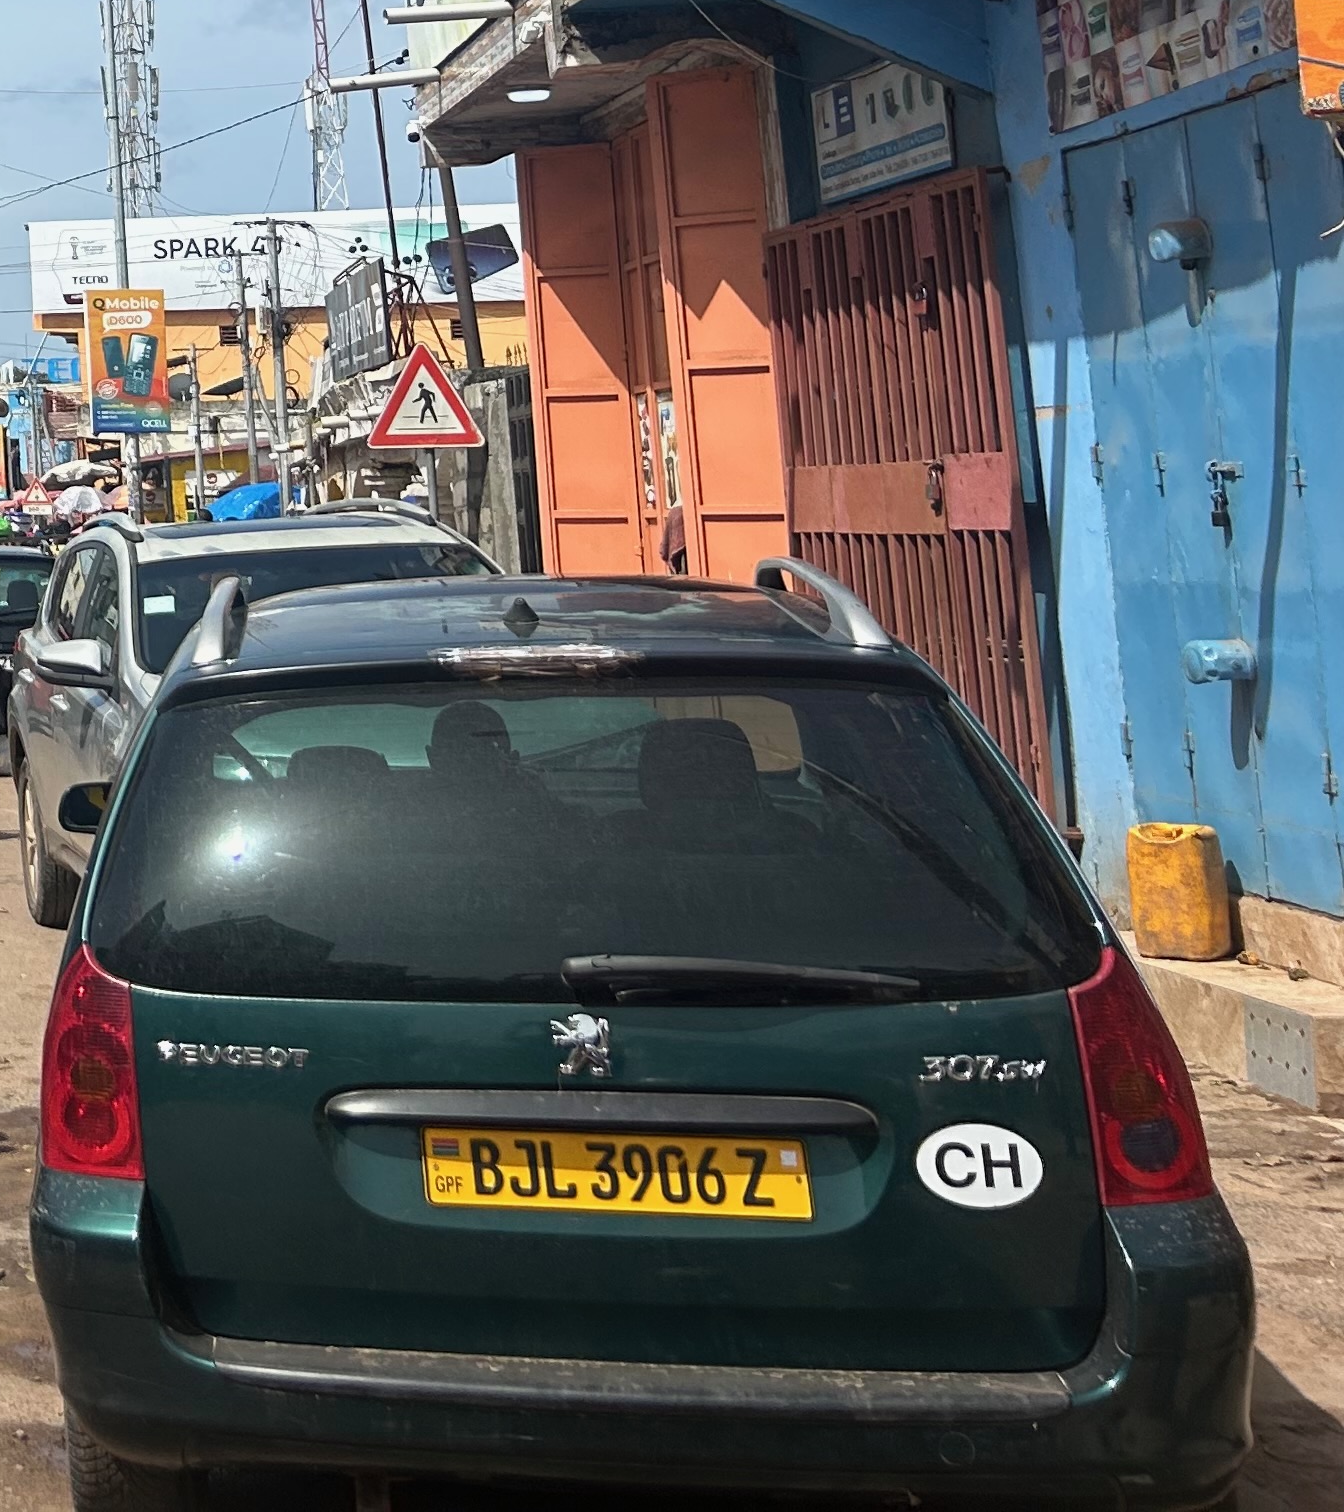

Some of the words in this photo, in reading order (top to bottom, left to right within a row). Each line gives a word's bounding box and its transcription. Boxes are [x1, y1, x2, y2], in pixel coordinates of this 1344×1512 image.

[153, 237, 238, 259] SPARK
[72, 275, 108, 285] TECNO
[93, 296, 159, 311] QMobile
[141, 419, 167, 428] QCELL
[157, 1040, 309, 1068] PEUGEOT
[469, 1137, 577, 1200] BJL
[585, 1142, 726, 1207] 3906
[735, 1148, 775, 1207] Z
[935, 1141, 1023, 1188] CH
[435, 1174, 463, 1194] GPF
